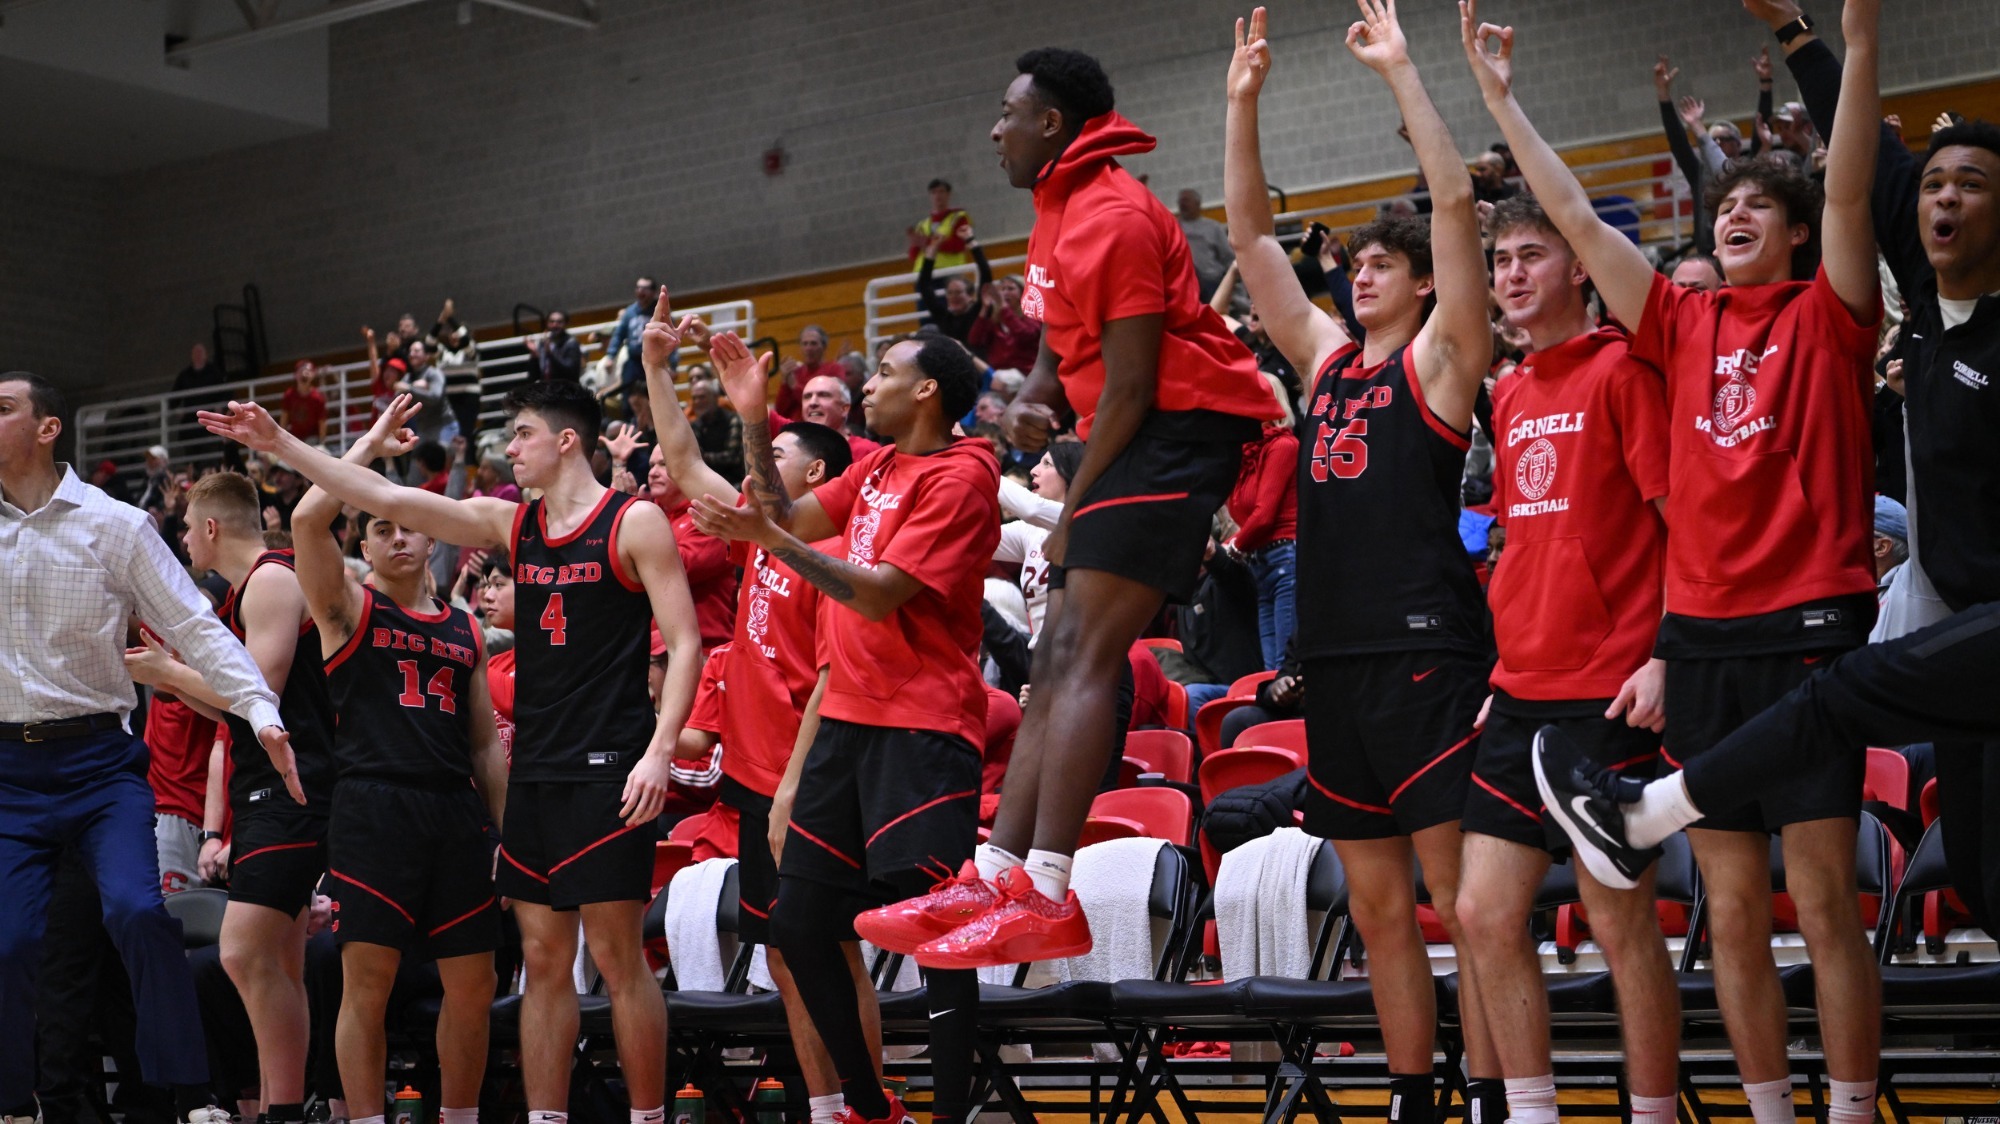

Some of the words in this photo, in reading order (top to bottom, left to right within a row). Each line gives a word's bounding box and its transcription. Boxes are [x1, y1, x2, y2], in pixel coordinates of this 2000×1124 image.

[1311, 418, 1367, 482] 55
[1508, 412, 1584, 447] CRNELL
[517, 563, 555, 585] BIG
[556, 562, 601, 585] RED
[540, 592, 567, 645] 4
[373, 628, 425, 652] BIG
[431, 637, 474, 668] RED
[398, 660, 455, 714] 14
